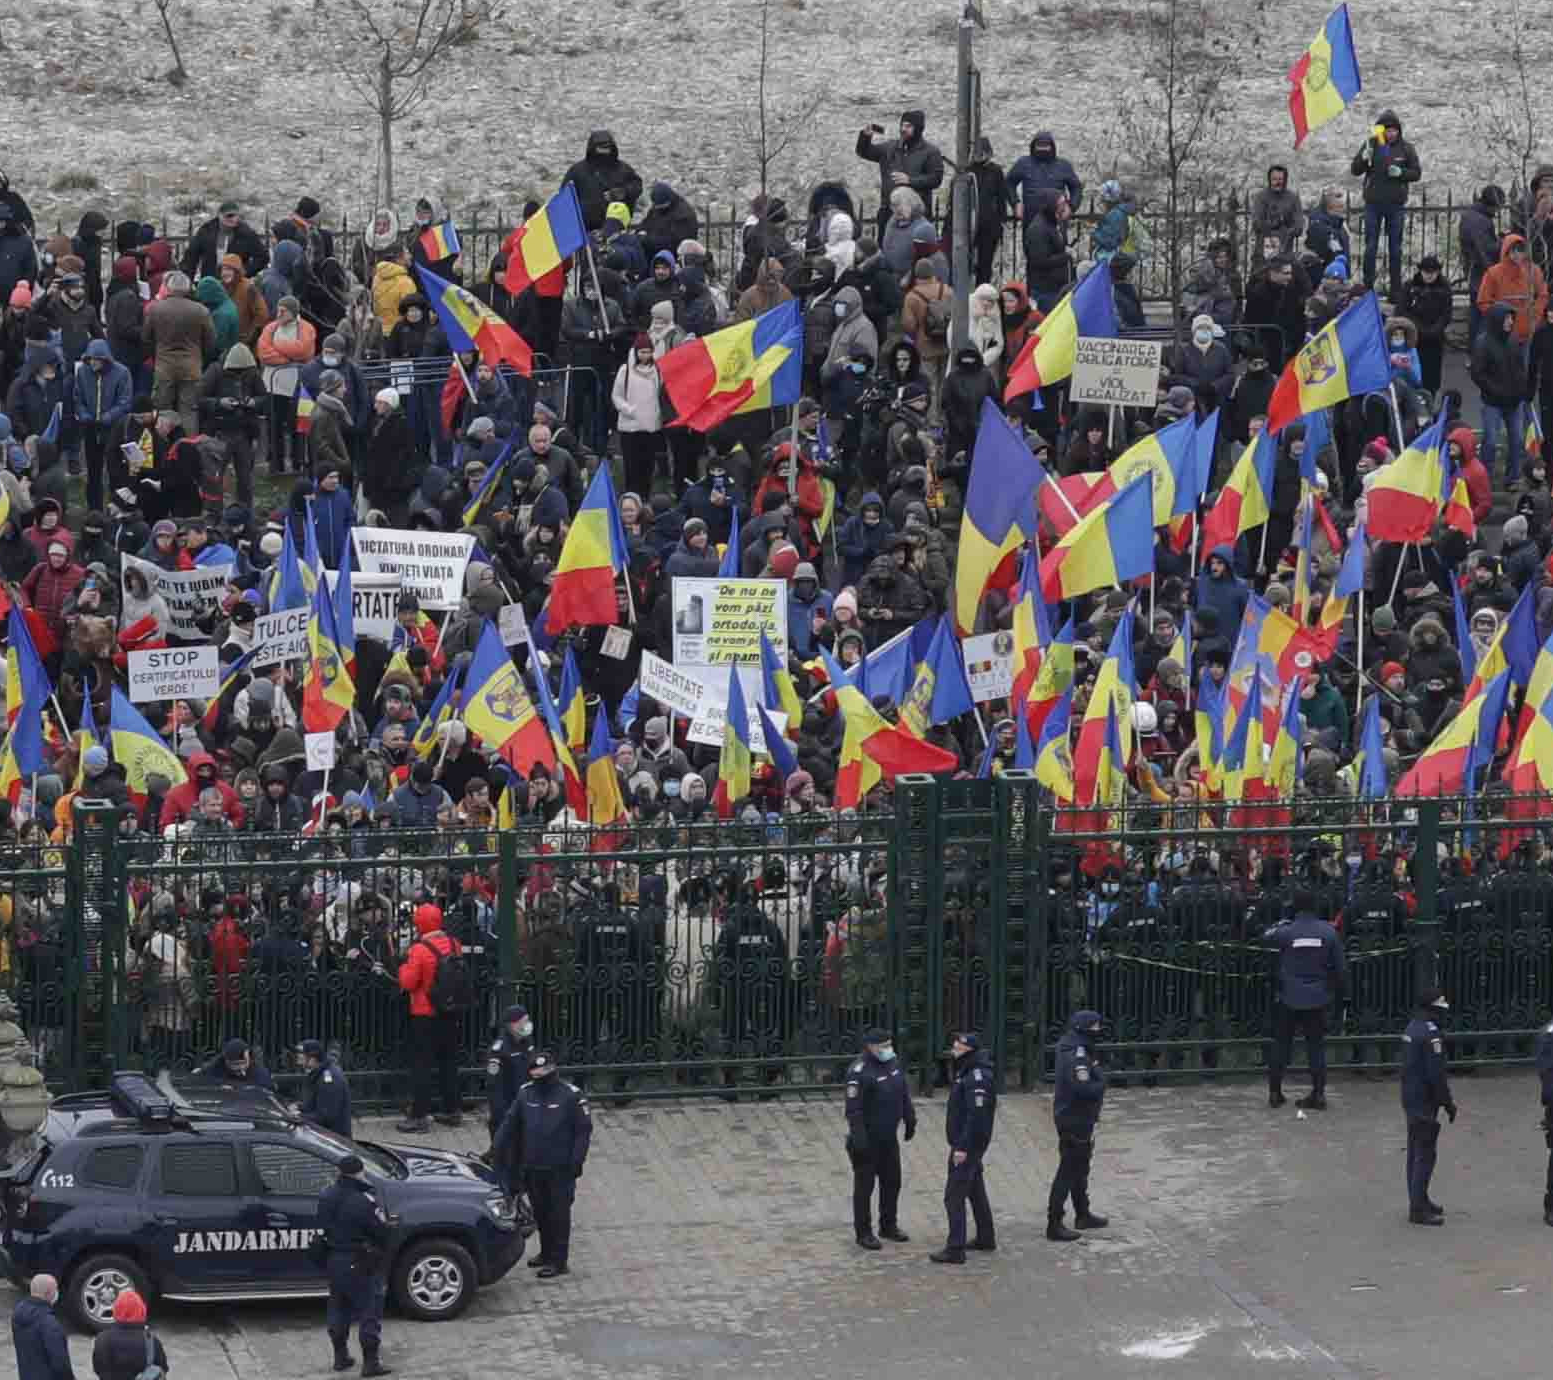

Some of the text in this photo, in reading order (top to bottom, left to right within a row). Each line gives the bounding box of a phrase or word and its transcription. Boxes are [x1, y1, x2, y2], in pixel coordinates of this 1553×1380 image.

[714, 603, 742, 613] vom
[148, 651, 200, 667] STOP
[132, 668, 218, 684] CERTIFICATULUI
[648, 658, 705, 700] LIBERTATE
[153, 683, 188, 696] VERDE
[48, 1173, 75, 1188] 112
[173, 1228, 328, 1254] JANDARME
